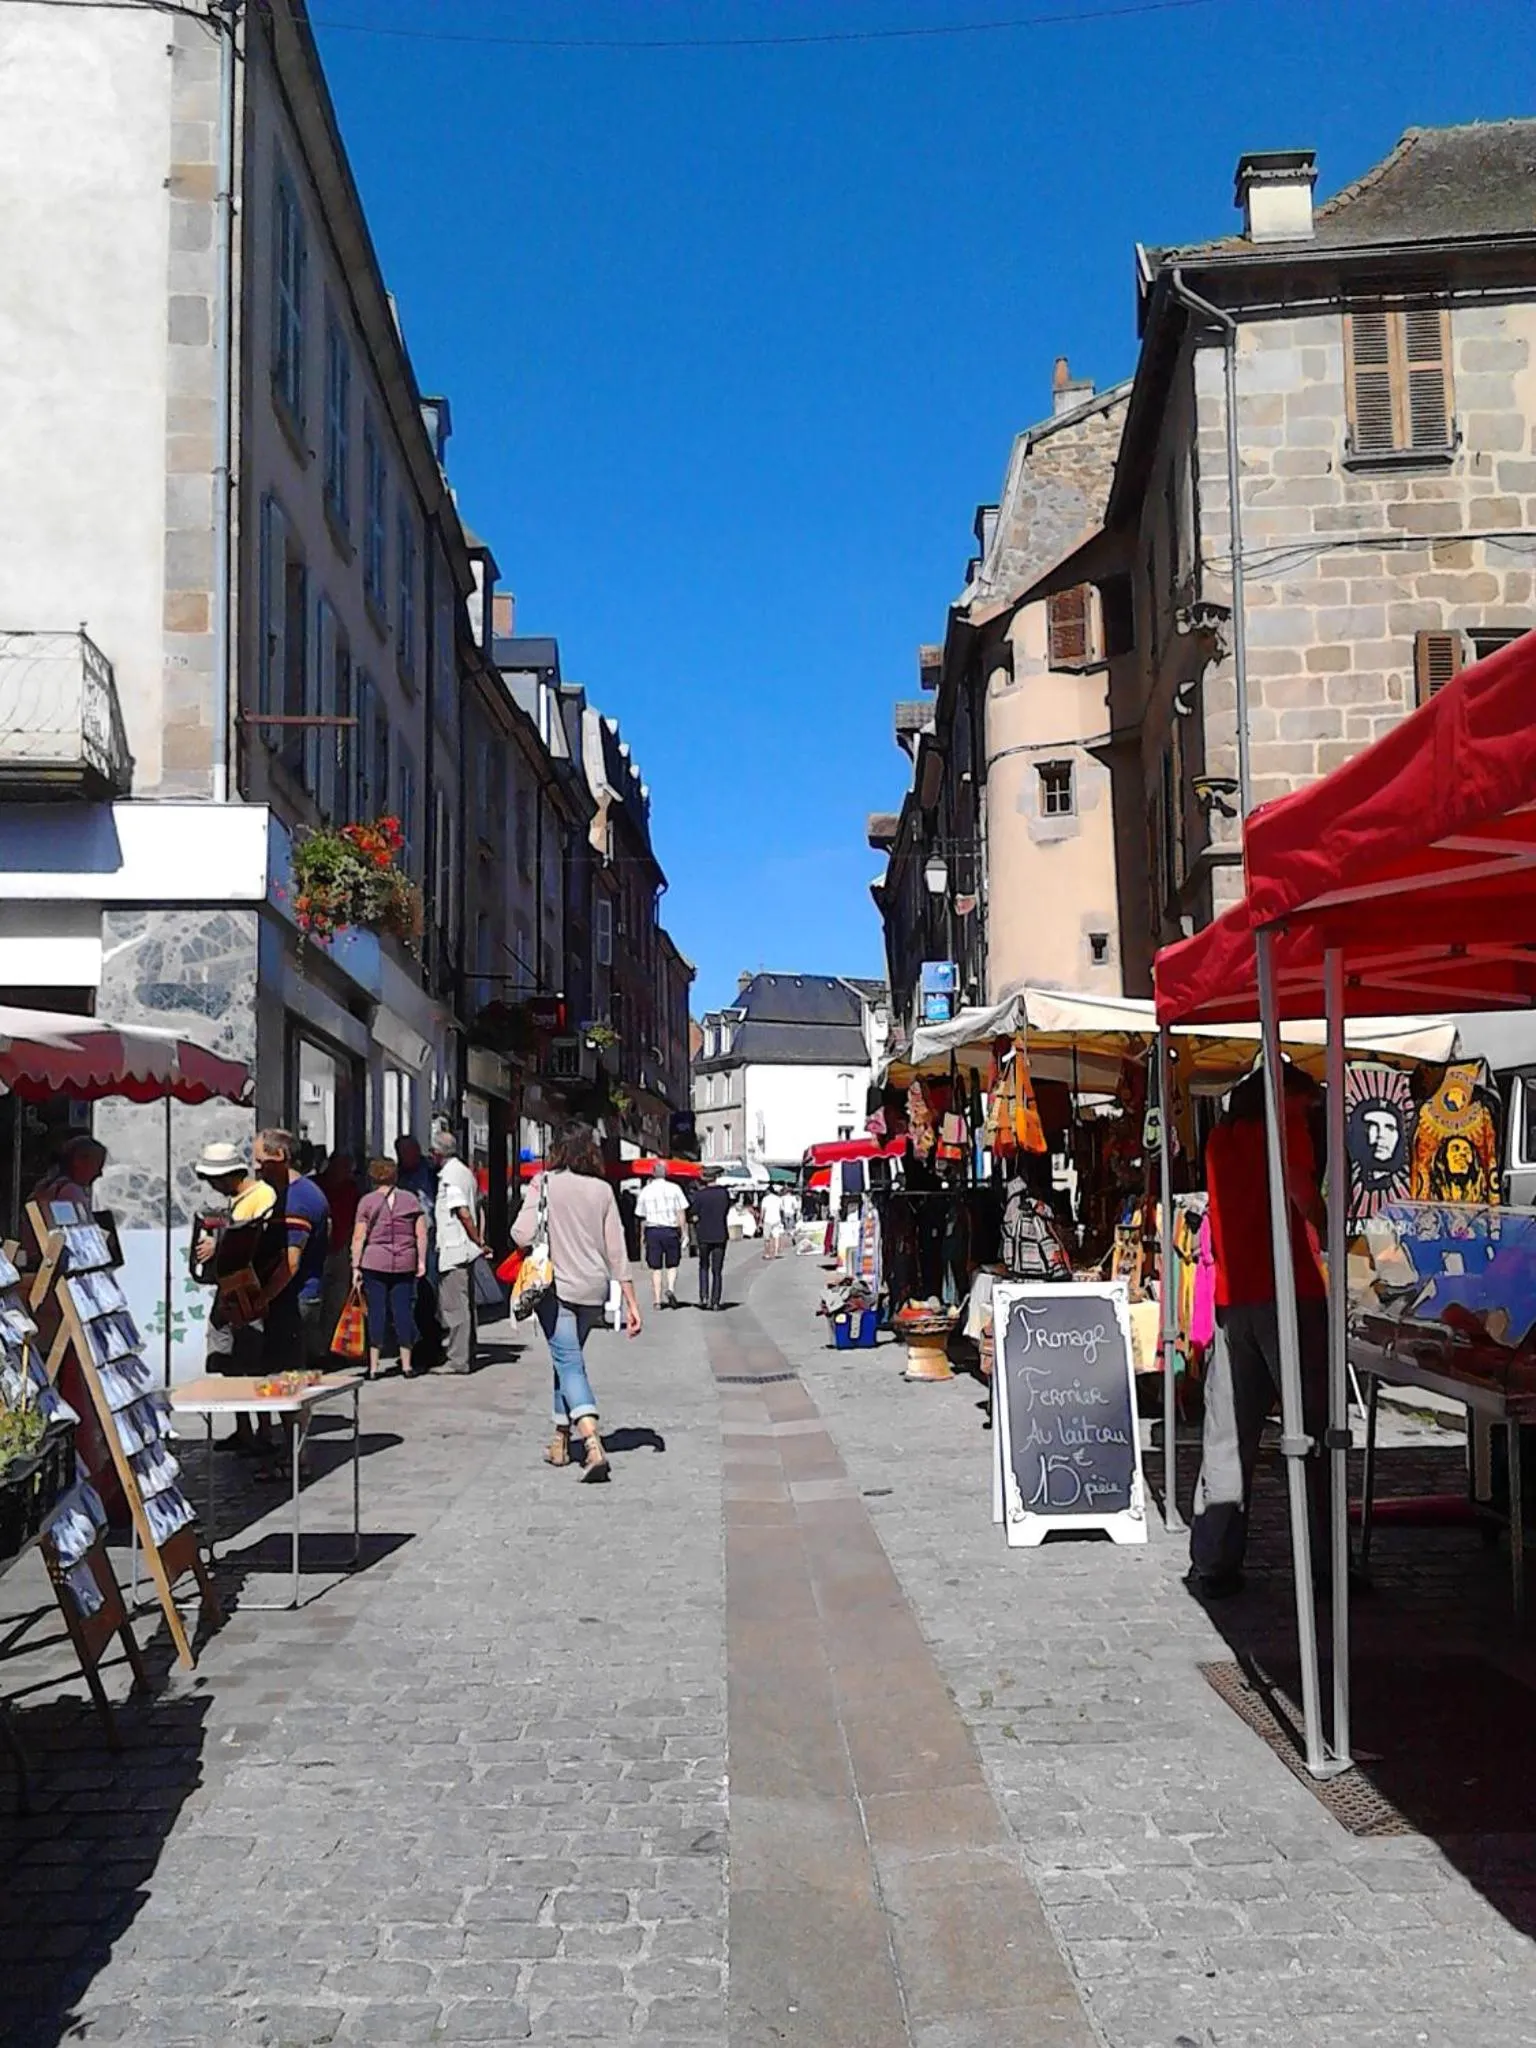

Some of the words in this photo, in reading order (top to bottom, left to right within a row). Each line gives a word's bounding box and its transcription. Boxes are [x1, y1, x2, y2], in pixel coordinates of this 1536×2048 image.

[1018, 1416, 1053, 1454] Au
[1056, 1415, 1096, 1446] lait
[1095, 1426, 1129, 1446] cru
